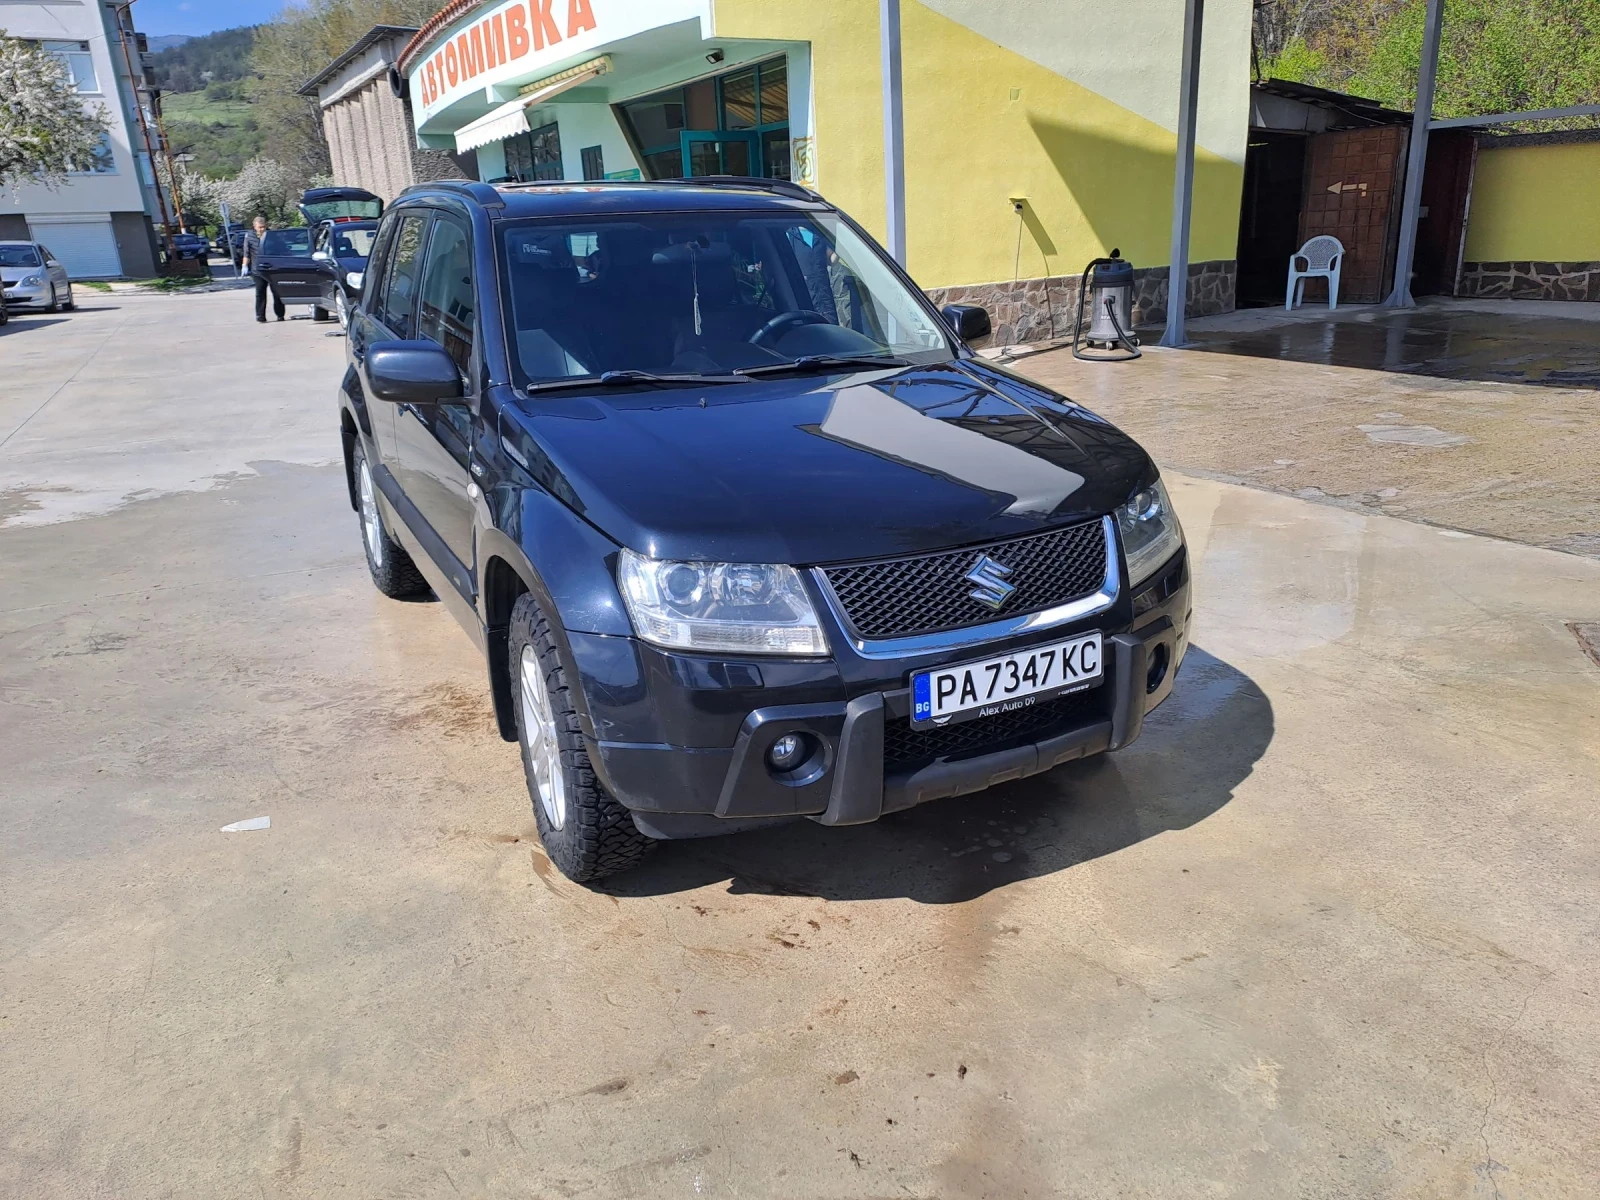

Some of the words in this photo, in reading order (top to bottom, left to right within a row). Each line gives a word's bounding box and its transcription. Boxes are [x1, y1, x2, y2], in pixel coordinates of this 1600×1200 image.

[420, 0, 597, 108] АВТОМИВКА
[915, 700, 930, 714] BG
[978, 704, 1000, 718] Alex
[1001, 699, 1023, 712] Auto
[1024, 696, 1036, 707] 09
